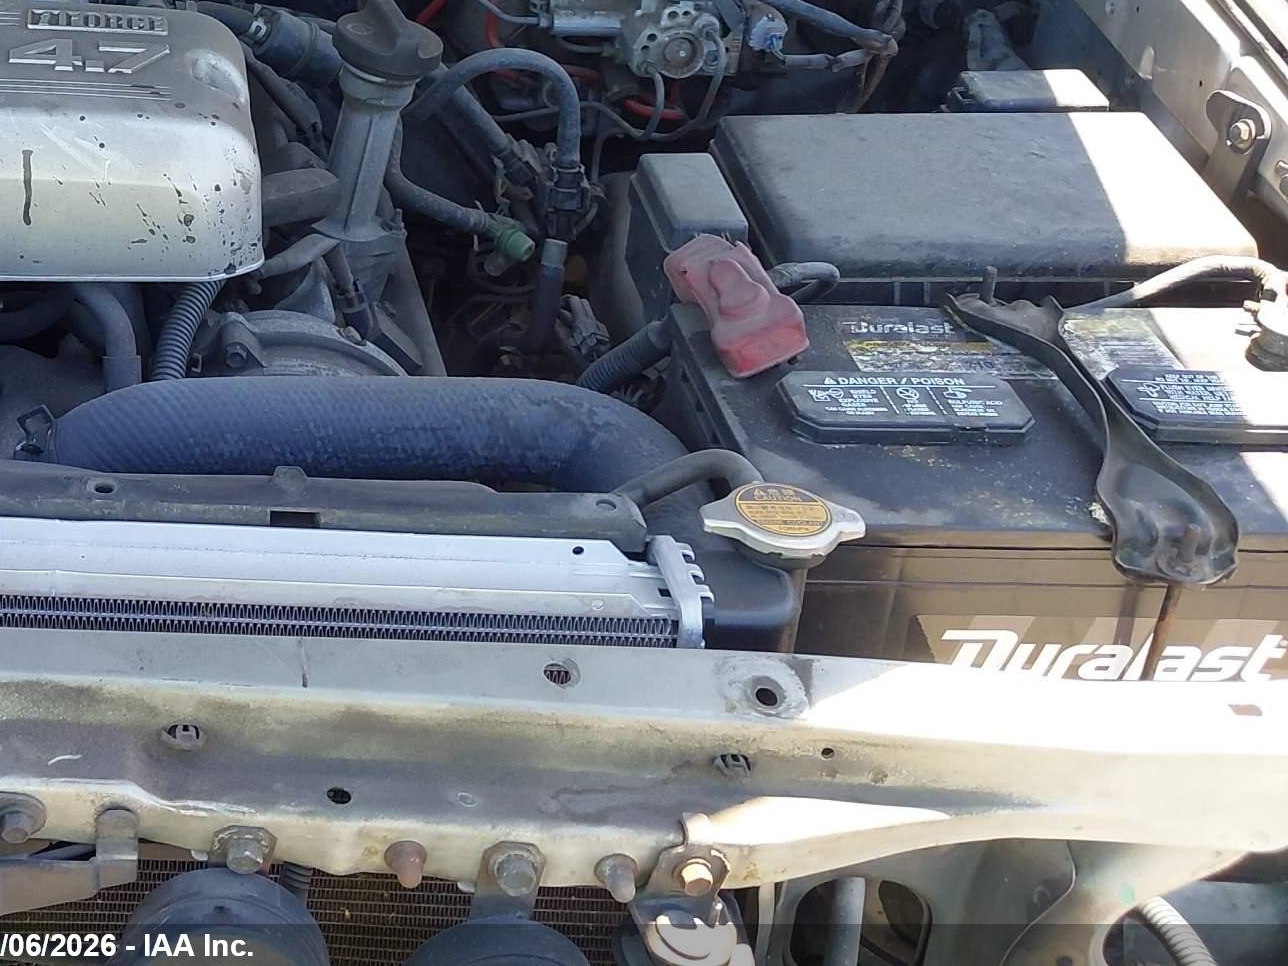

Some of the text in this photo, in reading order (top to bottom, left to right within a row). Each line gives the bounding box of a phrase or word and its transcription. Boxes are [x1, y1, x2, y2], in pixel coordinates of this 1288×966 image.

[8, 37, 171, 74] 4.7
[841, 320, 956, 334] Duralast
[837, 377, 897, 385] DANGER
[911, 377, 966, 386] POISON
[941, 629, 1287, 682] Duralast
